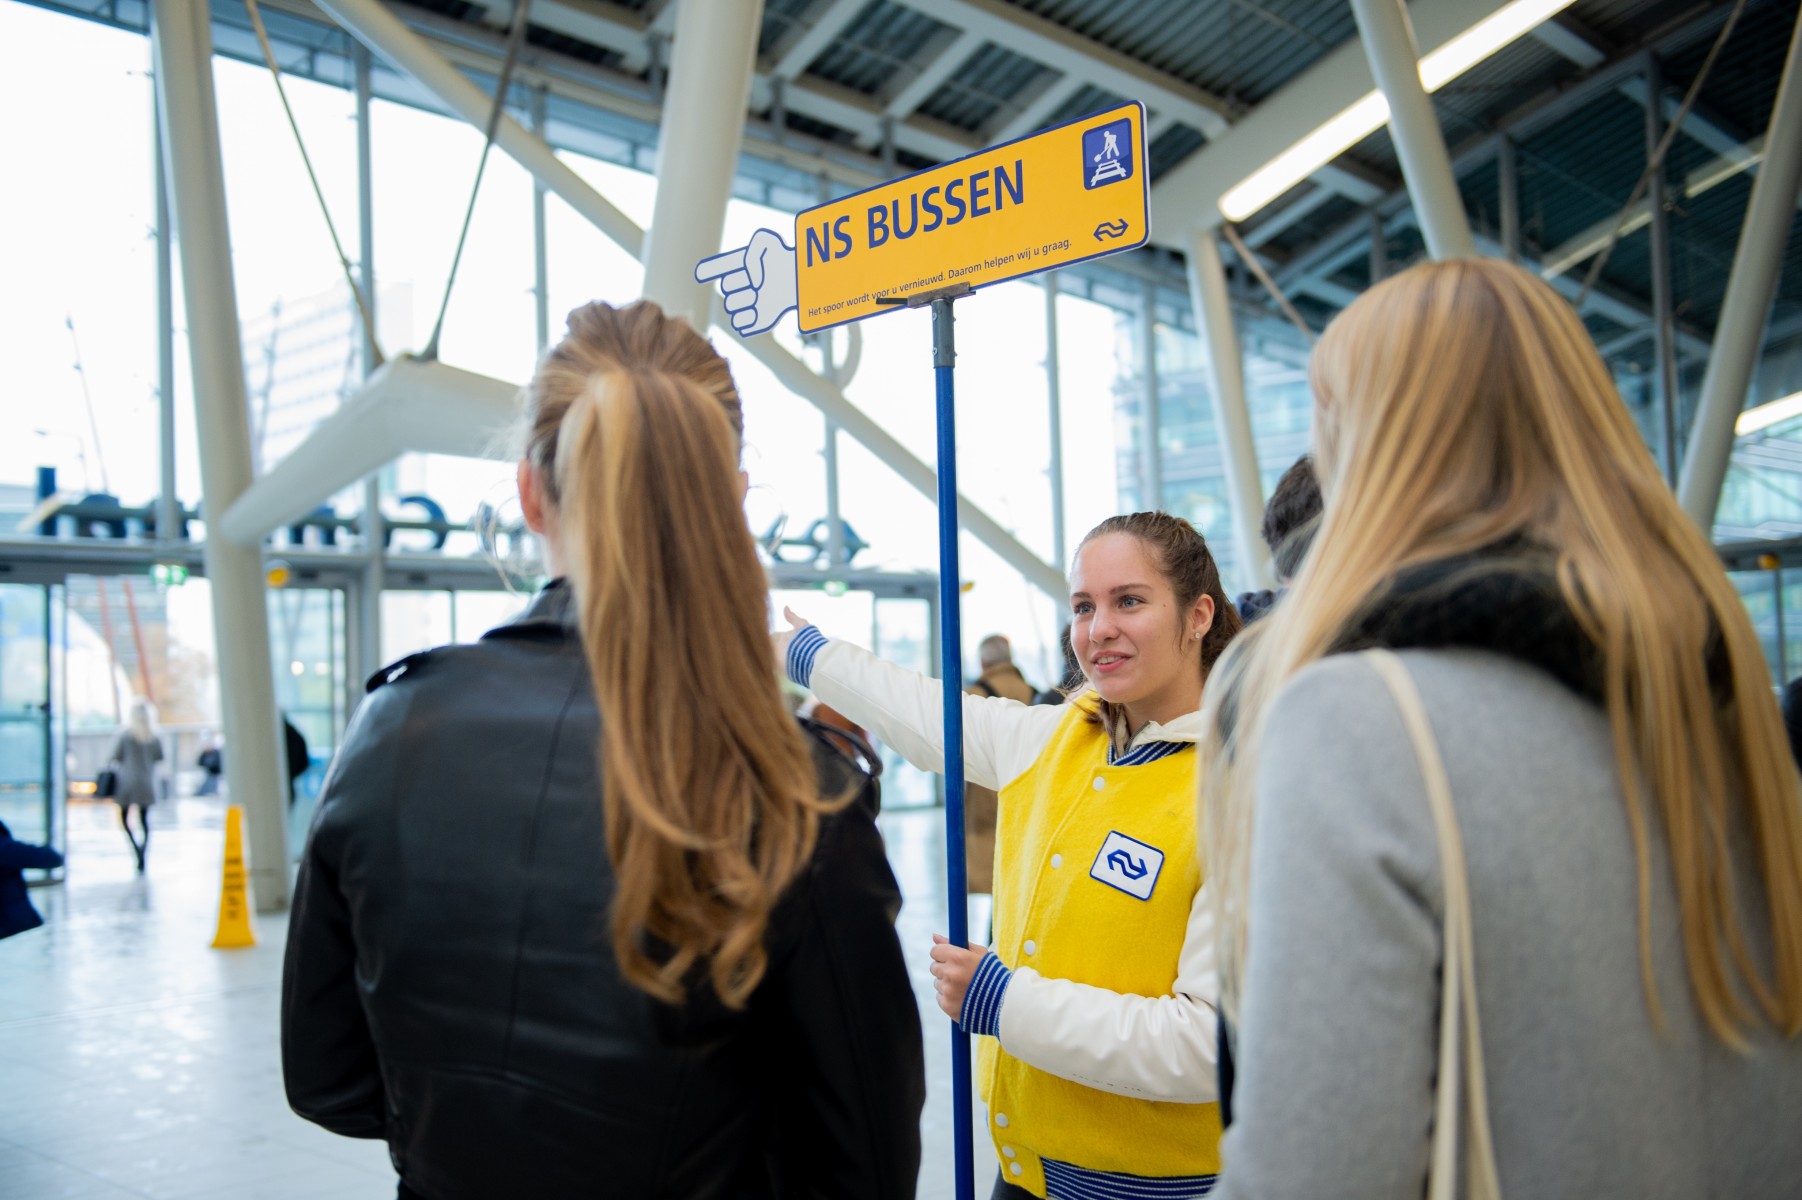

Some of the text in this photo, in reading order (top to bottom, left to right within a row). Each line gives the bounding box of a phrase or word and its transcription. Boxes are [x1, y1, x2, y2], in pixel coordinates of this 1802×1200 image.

[806, 159, 1025, 268] NS BUSSEN
[808, 307, 822, 317] Het
[823, 301, 845, 314] spoor
[846, 292, 870, 306] wordt
[871, 289, 890, 299] voor
[899, 272, 946, 292] vernieuwd.
[948, 263, 982, 279] Daarom
[984, 254, 1014, 269] helpen
[1016, 247, 1031, 260] wij
[1033, 247, 1040, 256] u
[1042, 239, 1072, 256] graag.
